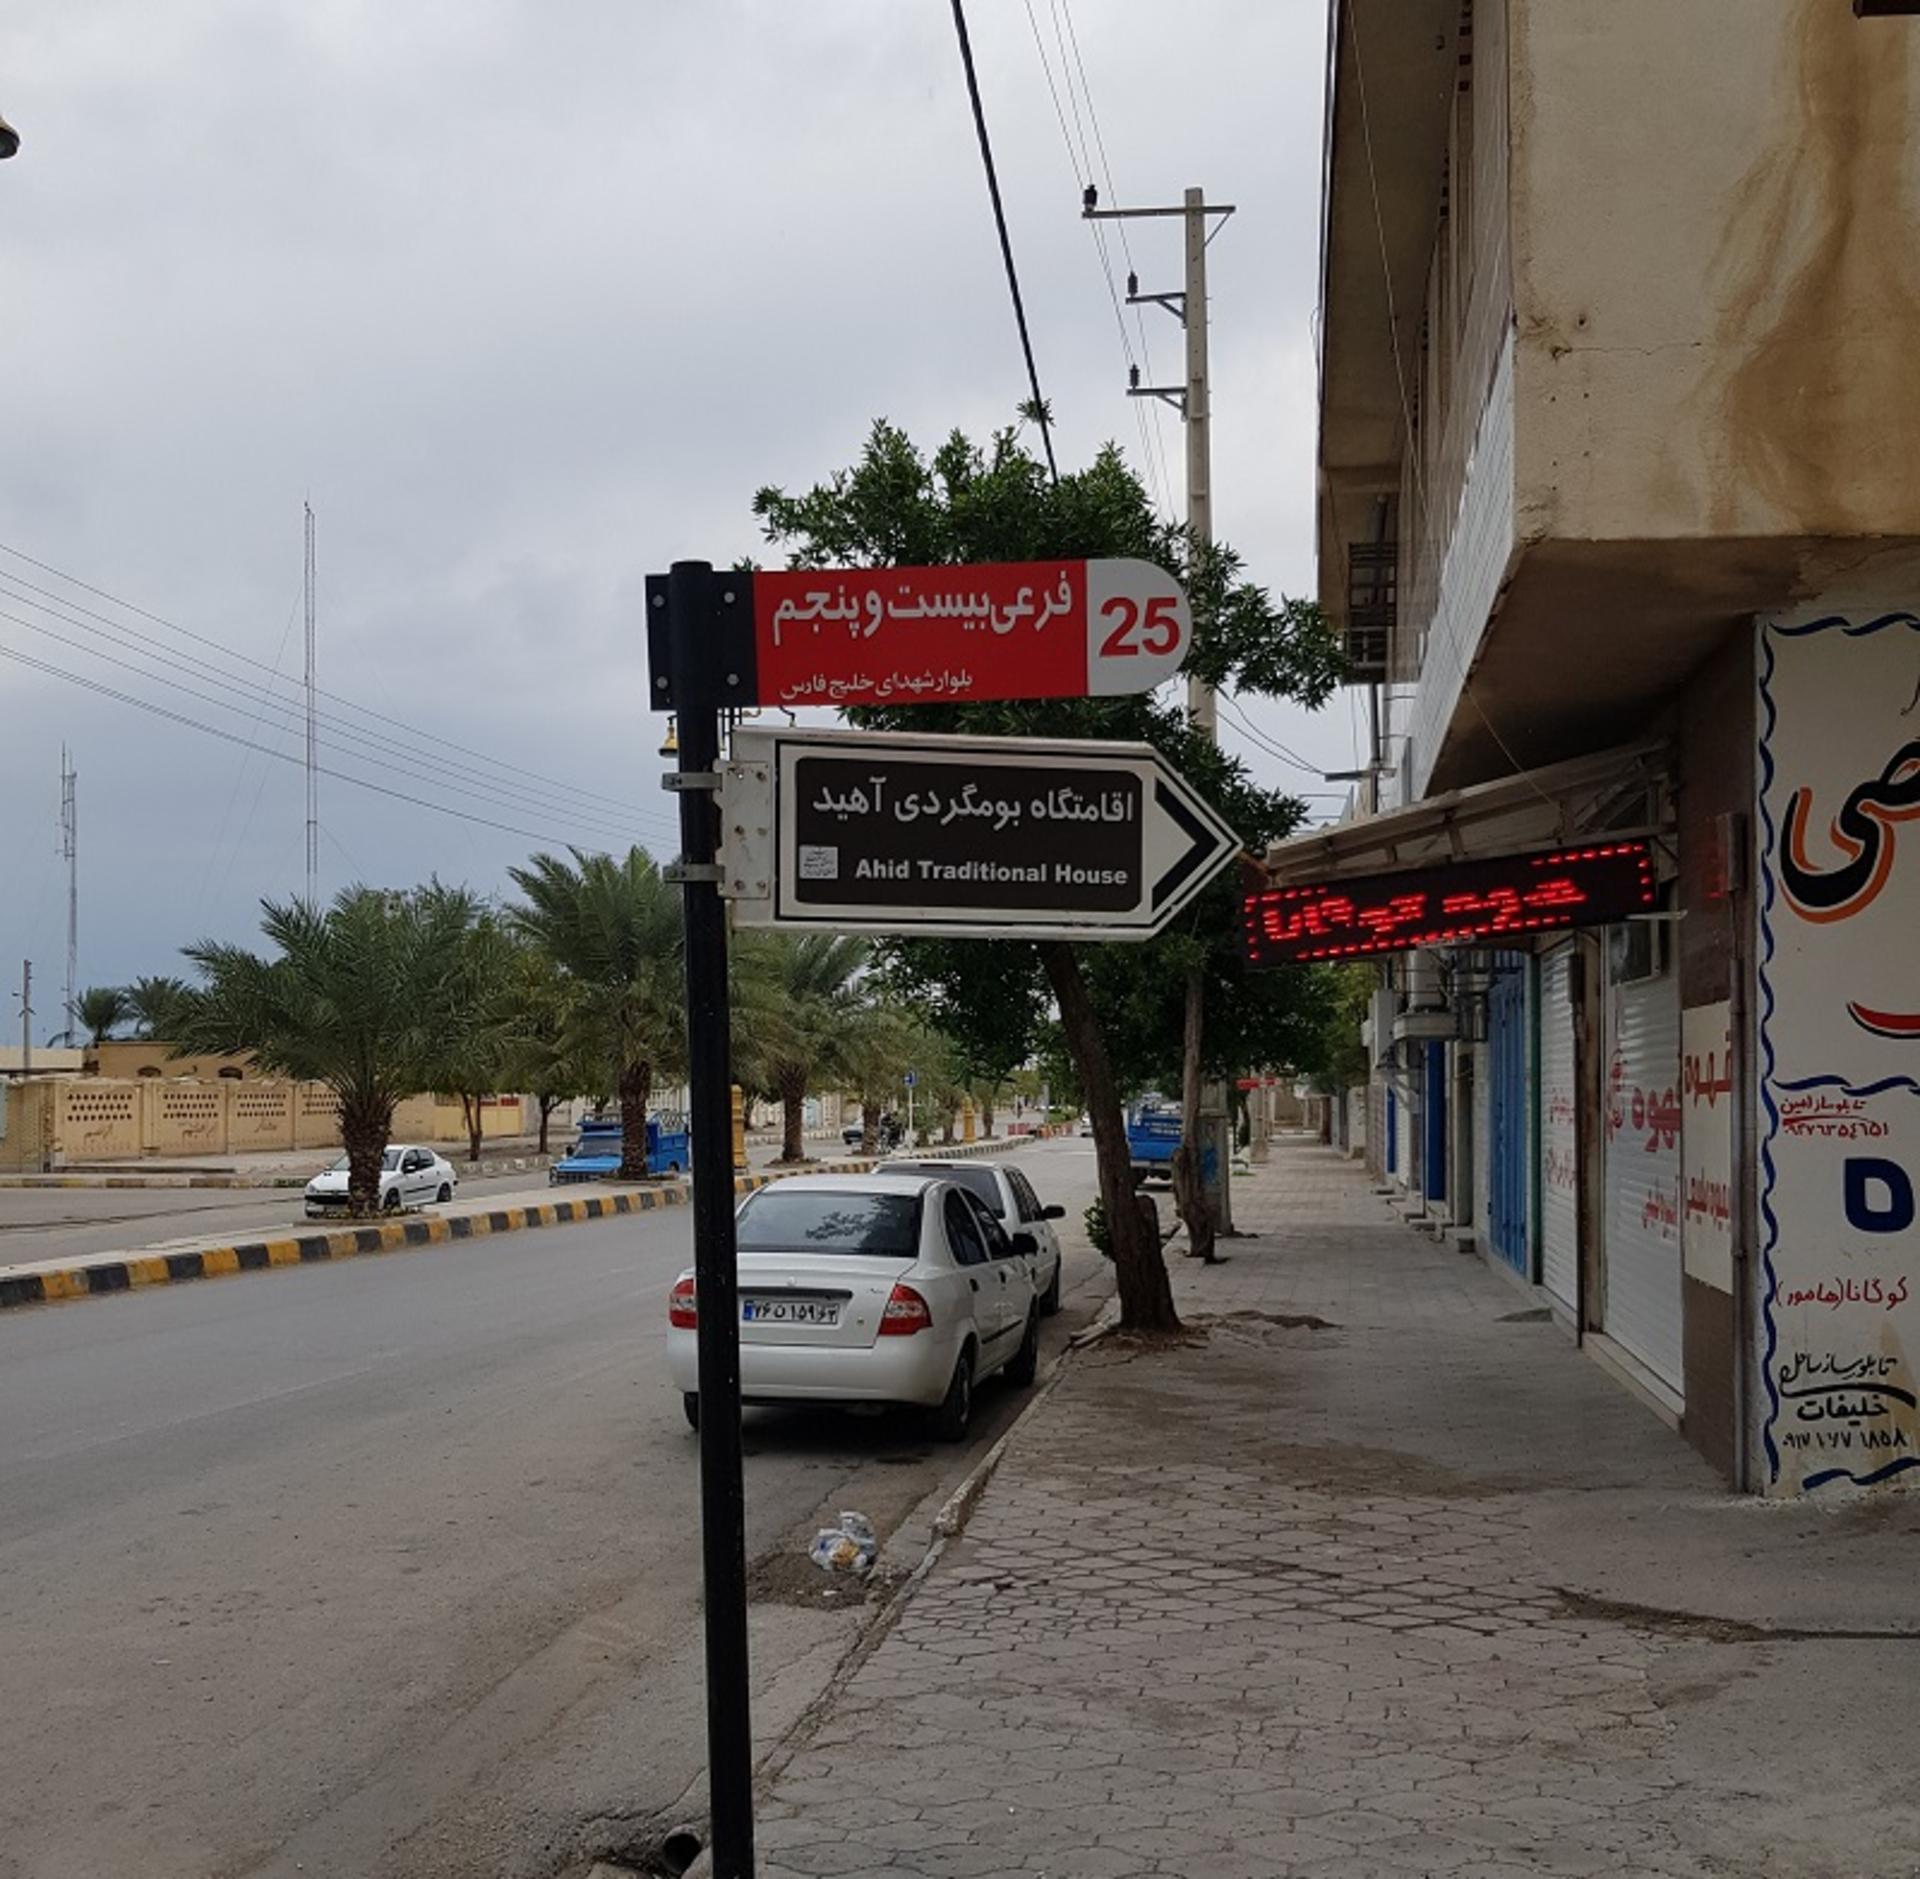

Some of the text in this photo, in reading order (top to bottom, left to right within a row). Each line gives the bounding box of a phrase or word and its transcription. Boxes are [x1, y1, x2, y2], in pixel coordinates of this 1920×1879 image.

[773, 570, 1072, 646] فرعی بیست و پنجم
[1099, 597, 1180, 658] 25
[779, 668, 974, 700] بلوار شهدای خلیج فارس
[812, 776, 1133, 831] اقامتگاه بومگردی آهید
[855, 859, 910, 879] Ahid
[917, 860, 1047, 882] Traditional
[1055, 864, 1128, 884] House
